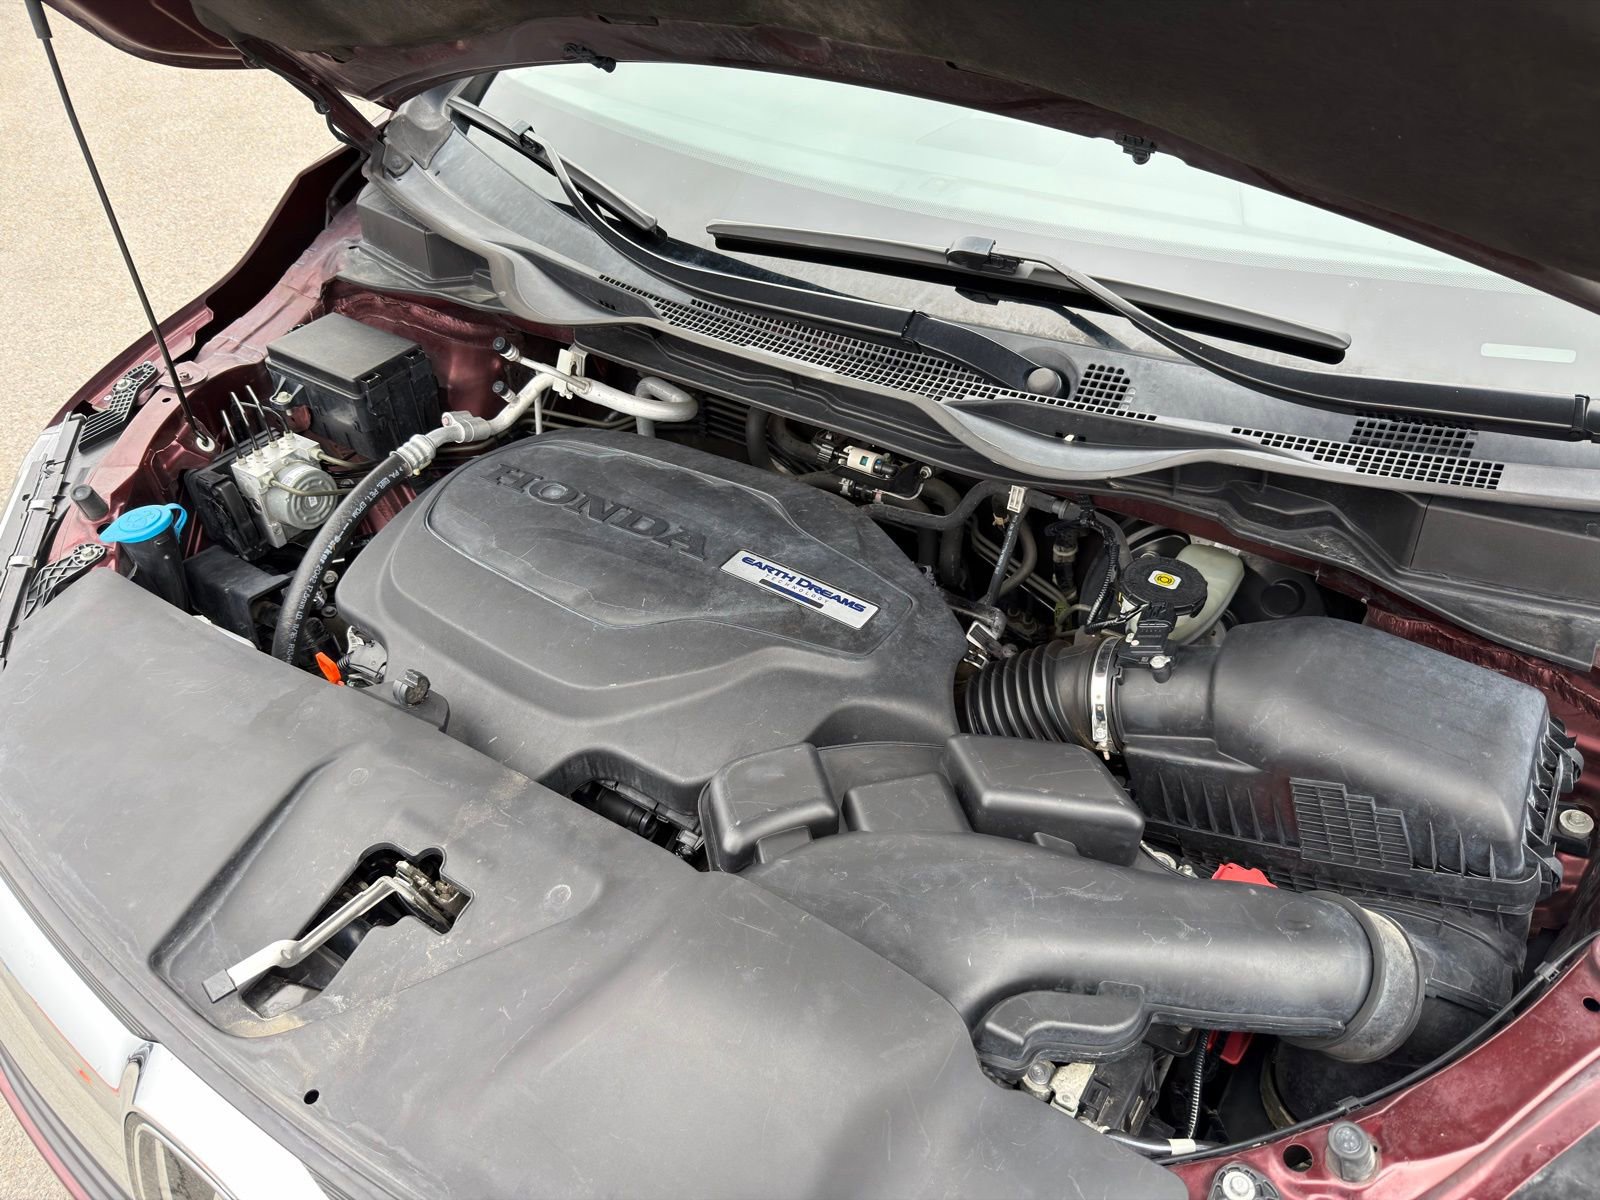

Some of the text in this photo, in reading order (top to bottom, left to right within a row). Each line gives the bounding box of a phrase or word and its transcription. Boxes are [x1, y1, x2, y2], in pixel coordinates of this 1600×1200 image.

[352, 501, 368, 518] EPDM
[480, 463, 711, 561] HONDA
[320, 534, 342, 564] Parker
[309, 564, 323, 584] 2042
[741, 556, 867, 613] EARTH DREAMS
[765, 573, 829, 604] TECHNOLOGY
